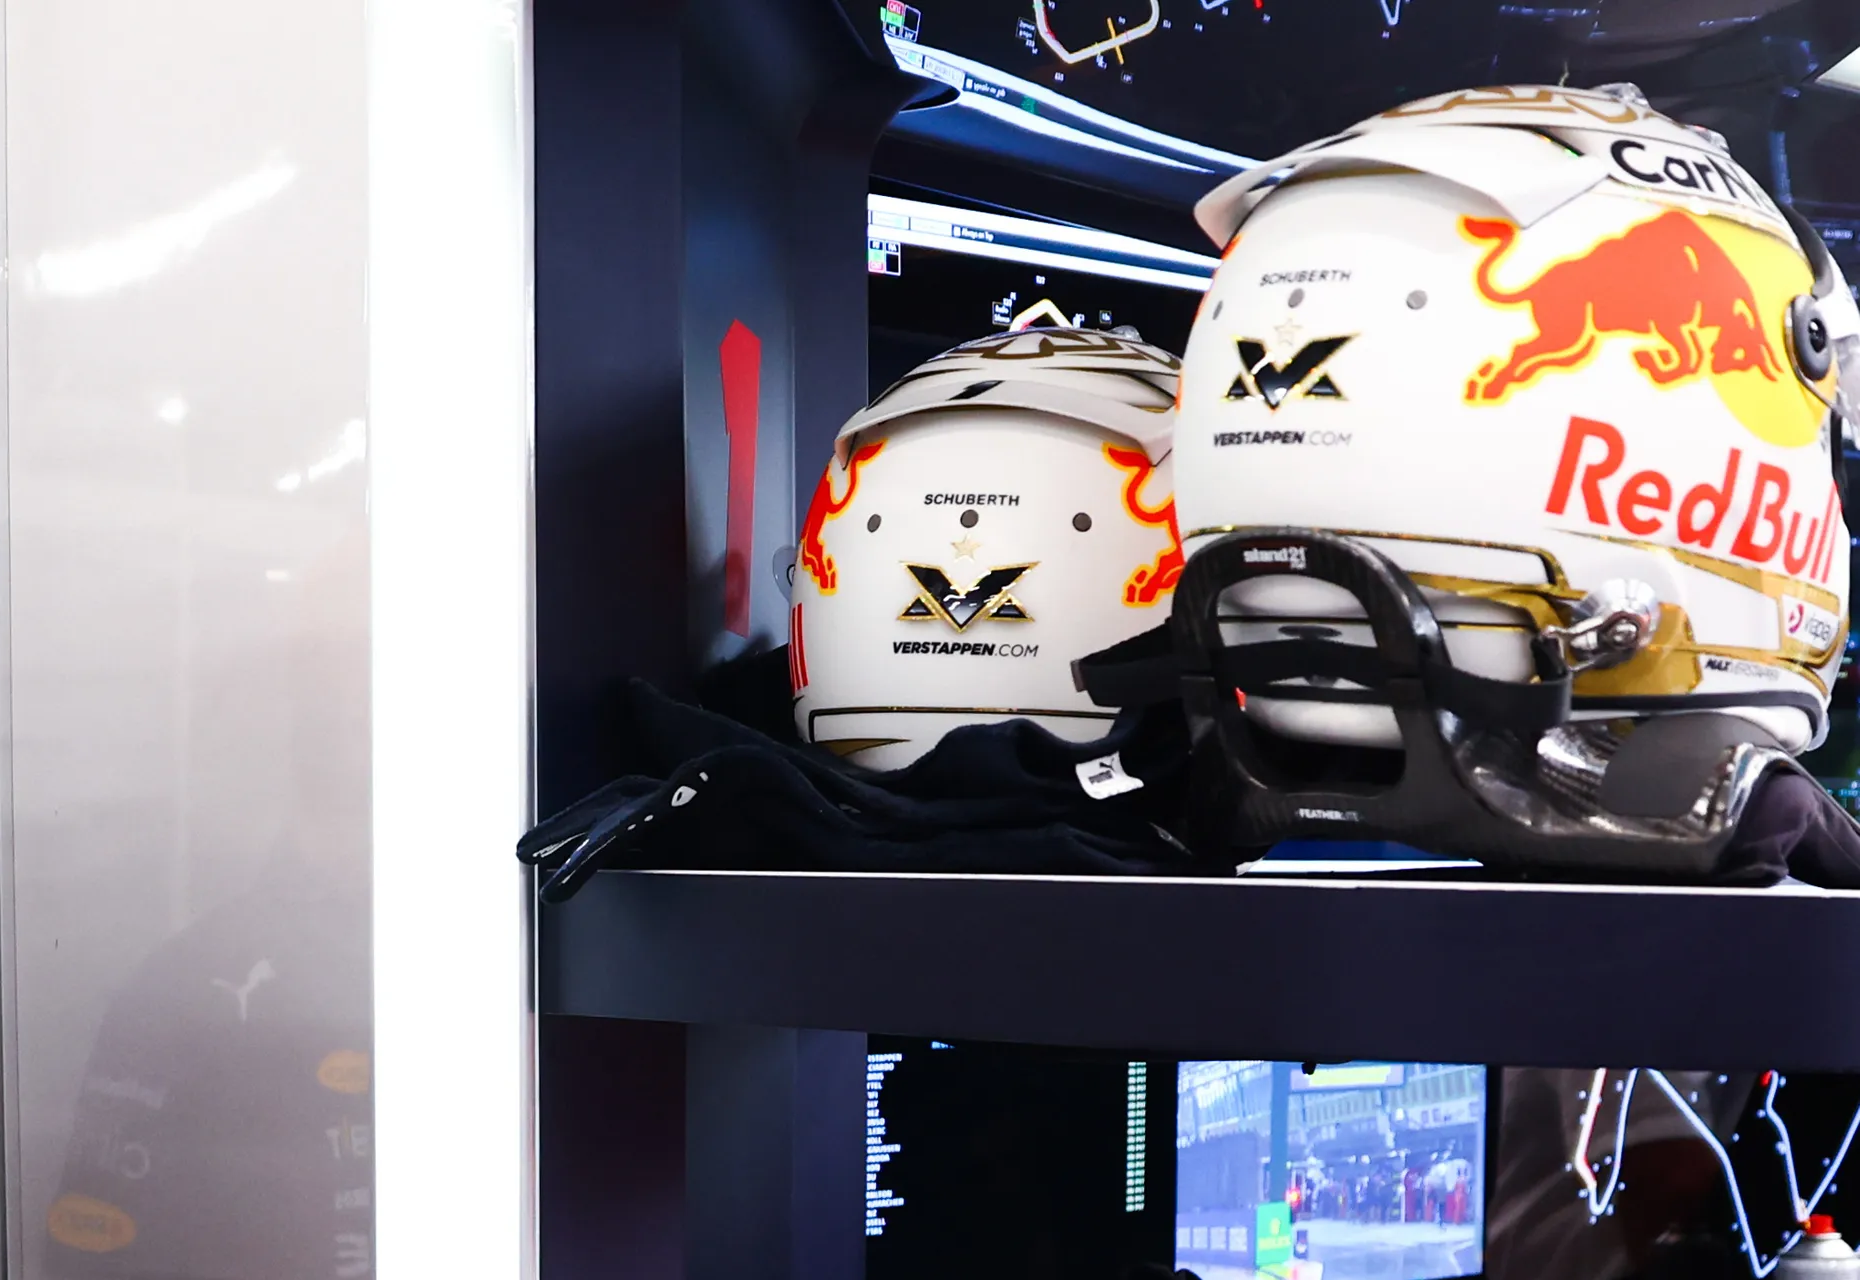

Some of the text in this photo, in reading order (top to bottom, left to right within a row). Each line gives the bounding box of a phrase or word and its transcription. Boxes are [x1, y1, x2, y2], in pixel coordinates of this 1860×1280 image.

[1259, 269, 1352, 286] SCHUBERTH
[924, 493, 1020, 507] SCHUBERTH
[1545, 415, 1843, 584] Red Bull
[893, 641, 1039, 658] VERSTAPPEN.COM
